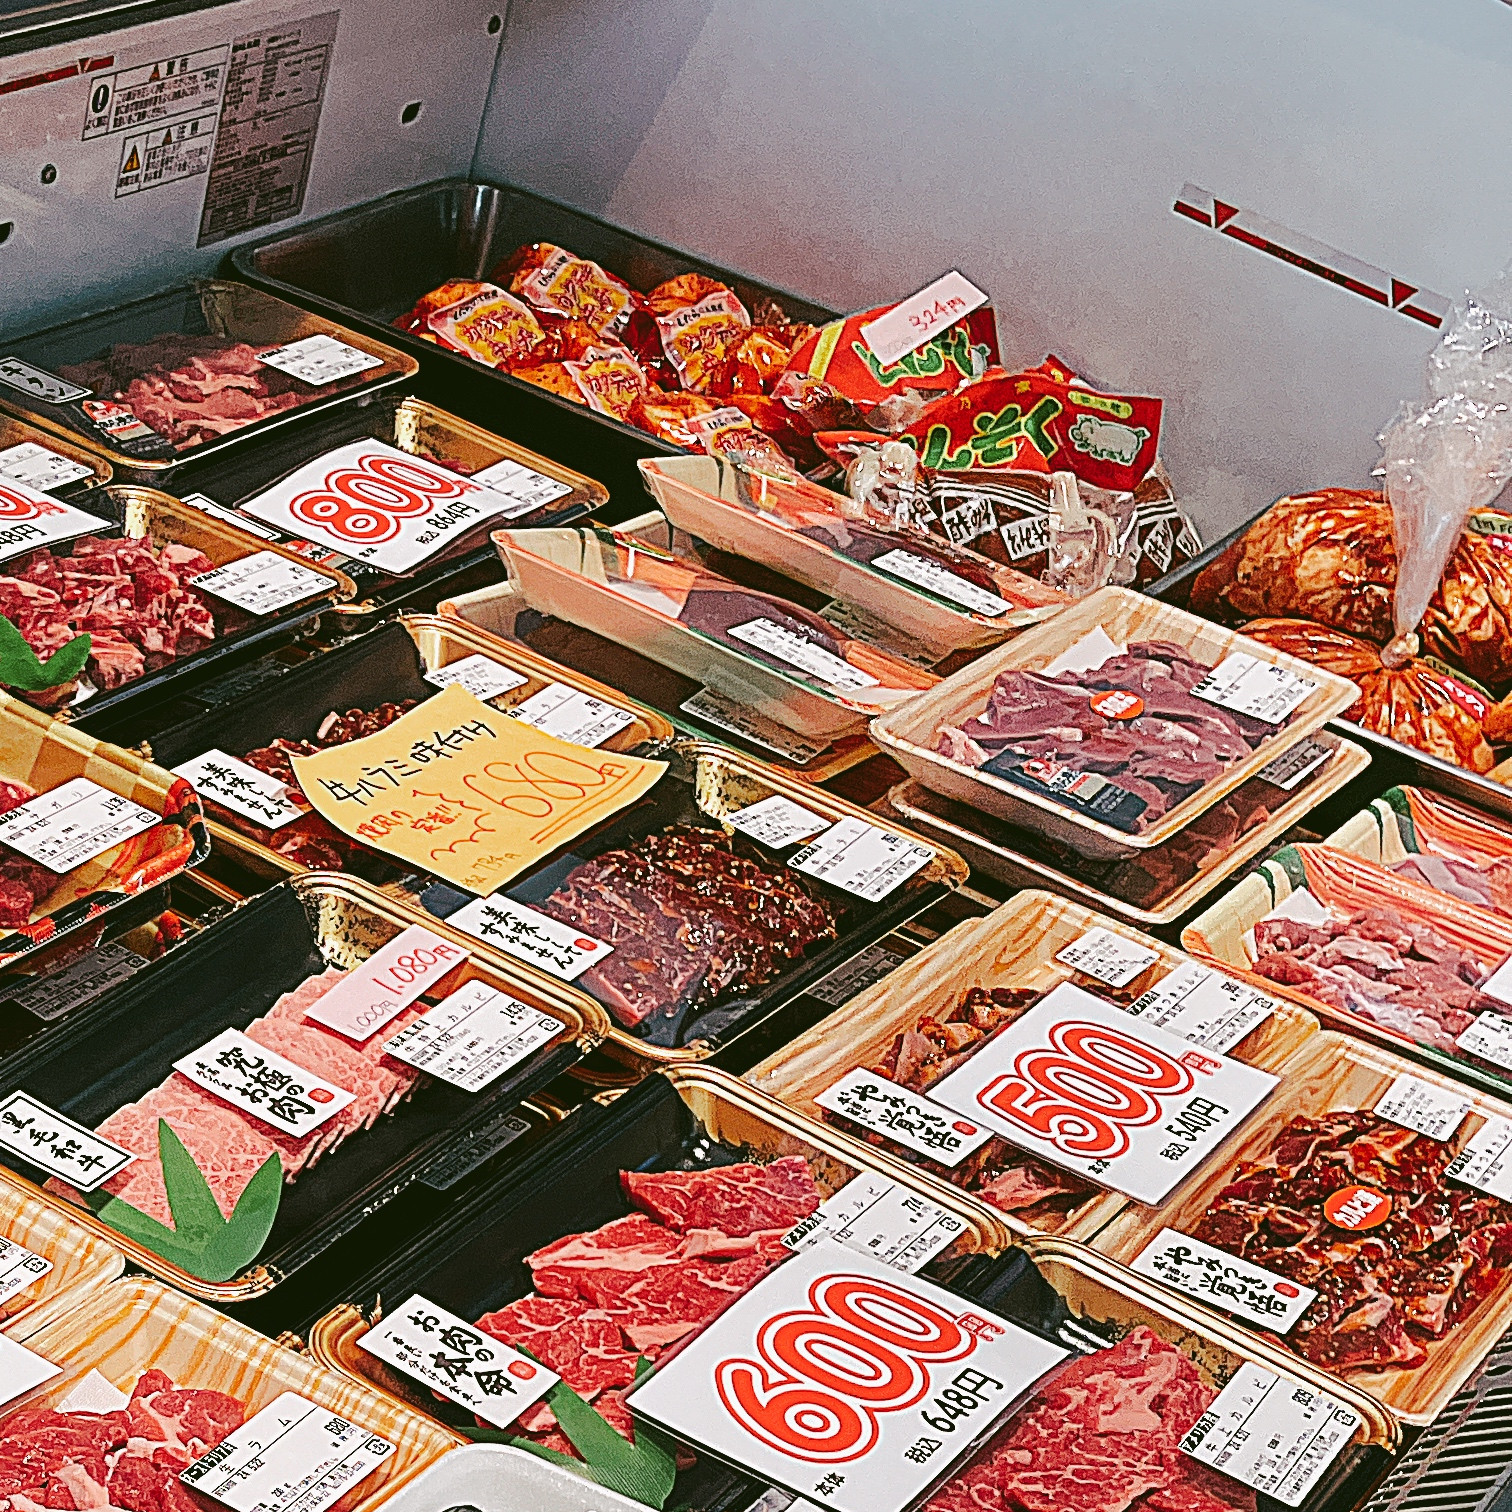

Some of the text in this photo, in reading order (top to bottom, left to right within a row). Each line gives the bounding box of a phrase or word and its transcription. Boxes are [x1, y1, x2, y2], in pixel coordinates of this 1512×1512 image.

[290, 453, 482, 545] 800円
[426, 501, 481, 532] 864円
[235, 1082, 316, 1125] お肉
[976, 1019, 1222, 1158] 500円
[1, 1111, 109, 1173] 黒毛和牛
[1164, 1096, 1231, 1143] 540円
[406, 1309, 495, 1362] お肉の
[428, 1351, 518, 1396] 本命
[715, 1273, 1005, 1464] 600円
[903, 1366, 1005, 1465] 税込 648円
[218, 1417, 293, 1475] 生ラム
[813, 1471, 847, 1498] 本体
